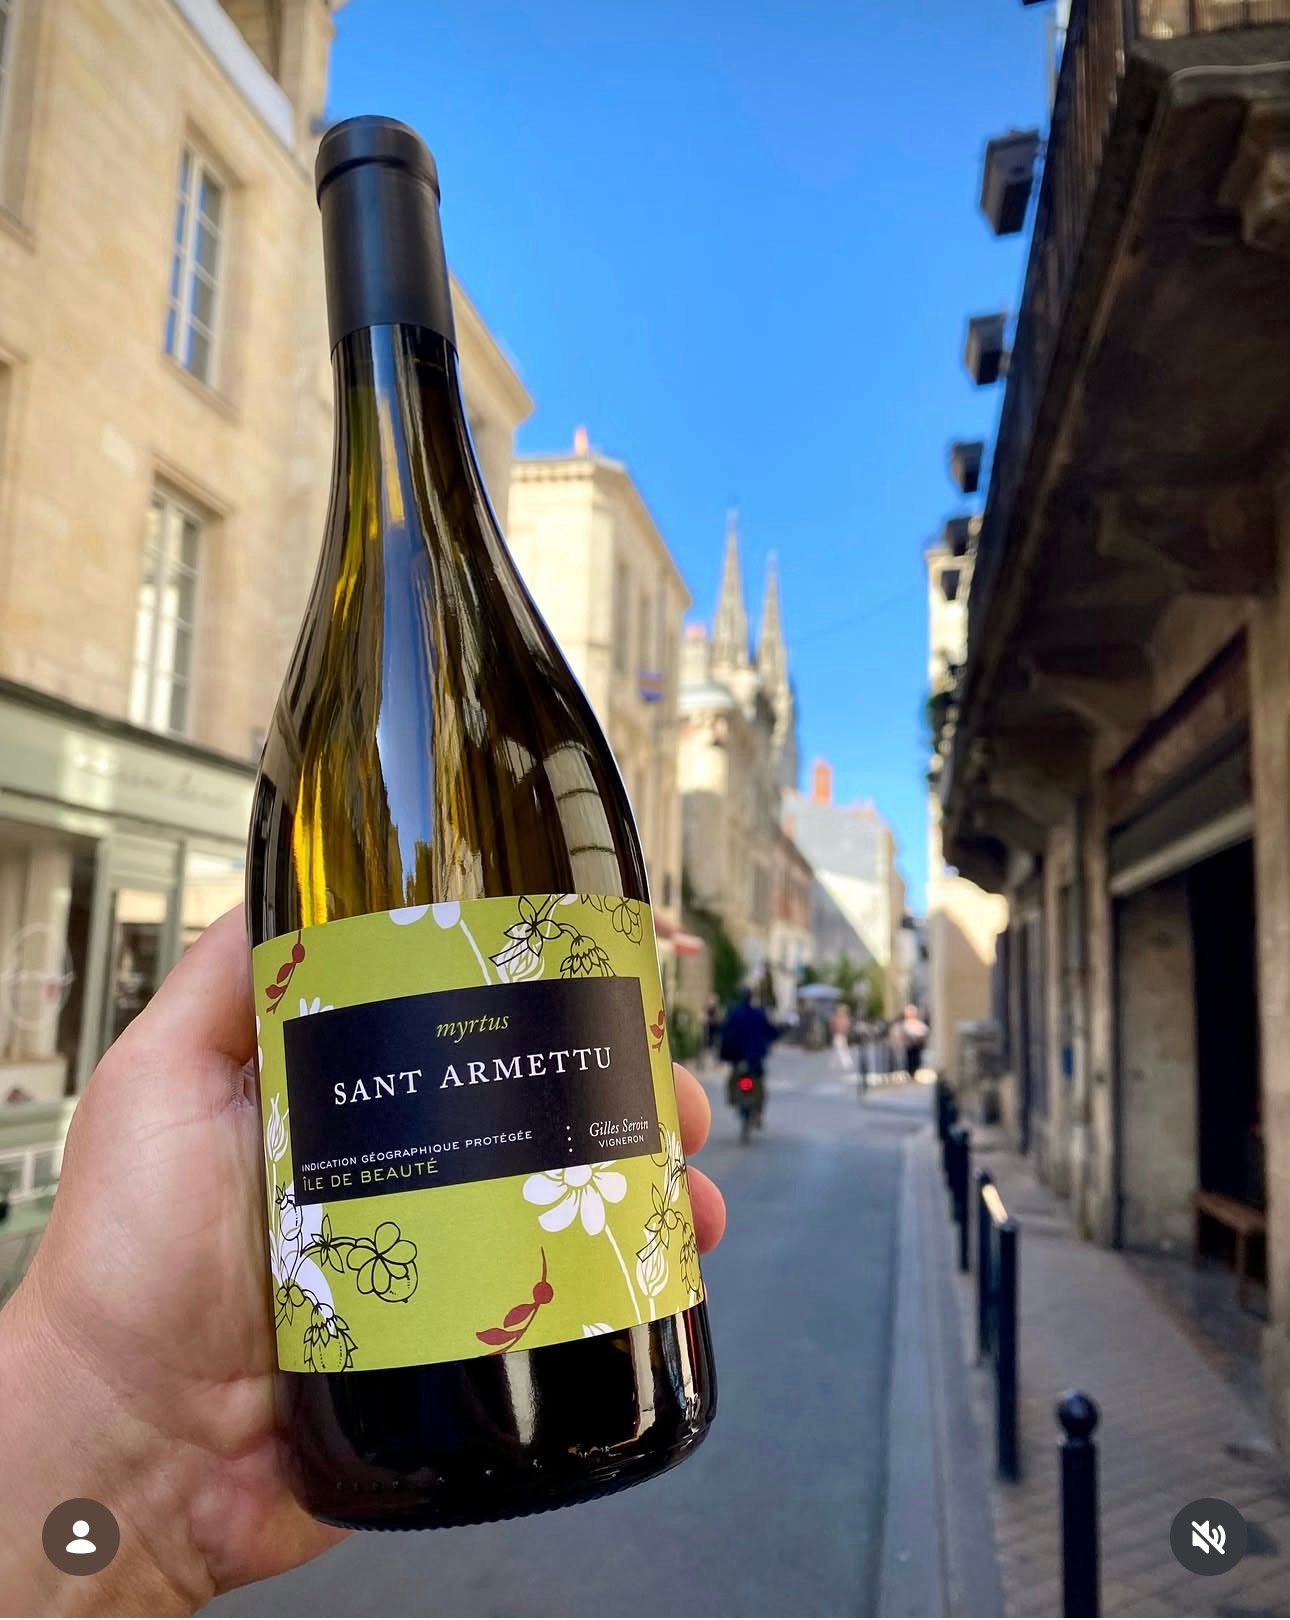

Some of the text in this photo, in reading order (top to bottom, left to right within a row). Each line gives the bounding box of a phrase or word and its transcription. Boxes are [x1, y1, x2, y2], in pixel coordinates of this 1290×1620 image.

[436, 1014, 510, 1044] myrtus
[333, 1046, 612, 1105] SANT ARMETTU
[589, 1116, 649, 1137] Gilles Seroin
[598, 1134, 645, 1148] VIGNERON
[301, 1130, 533, 1173] INDICATION GÉOGRAPHIQUE PROTÉGÉE
[302, 1157, 439, 1192] ÎLE DE BEAUTÉ
